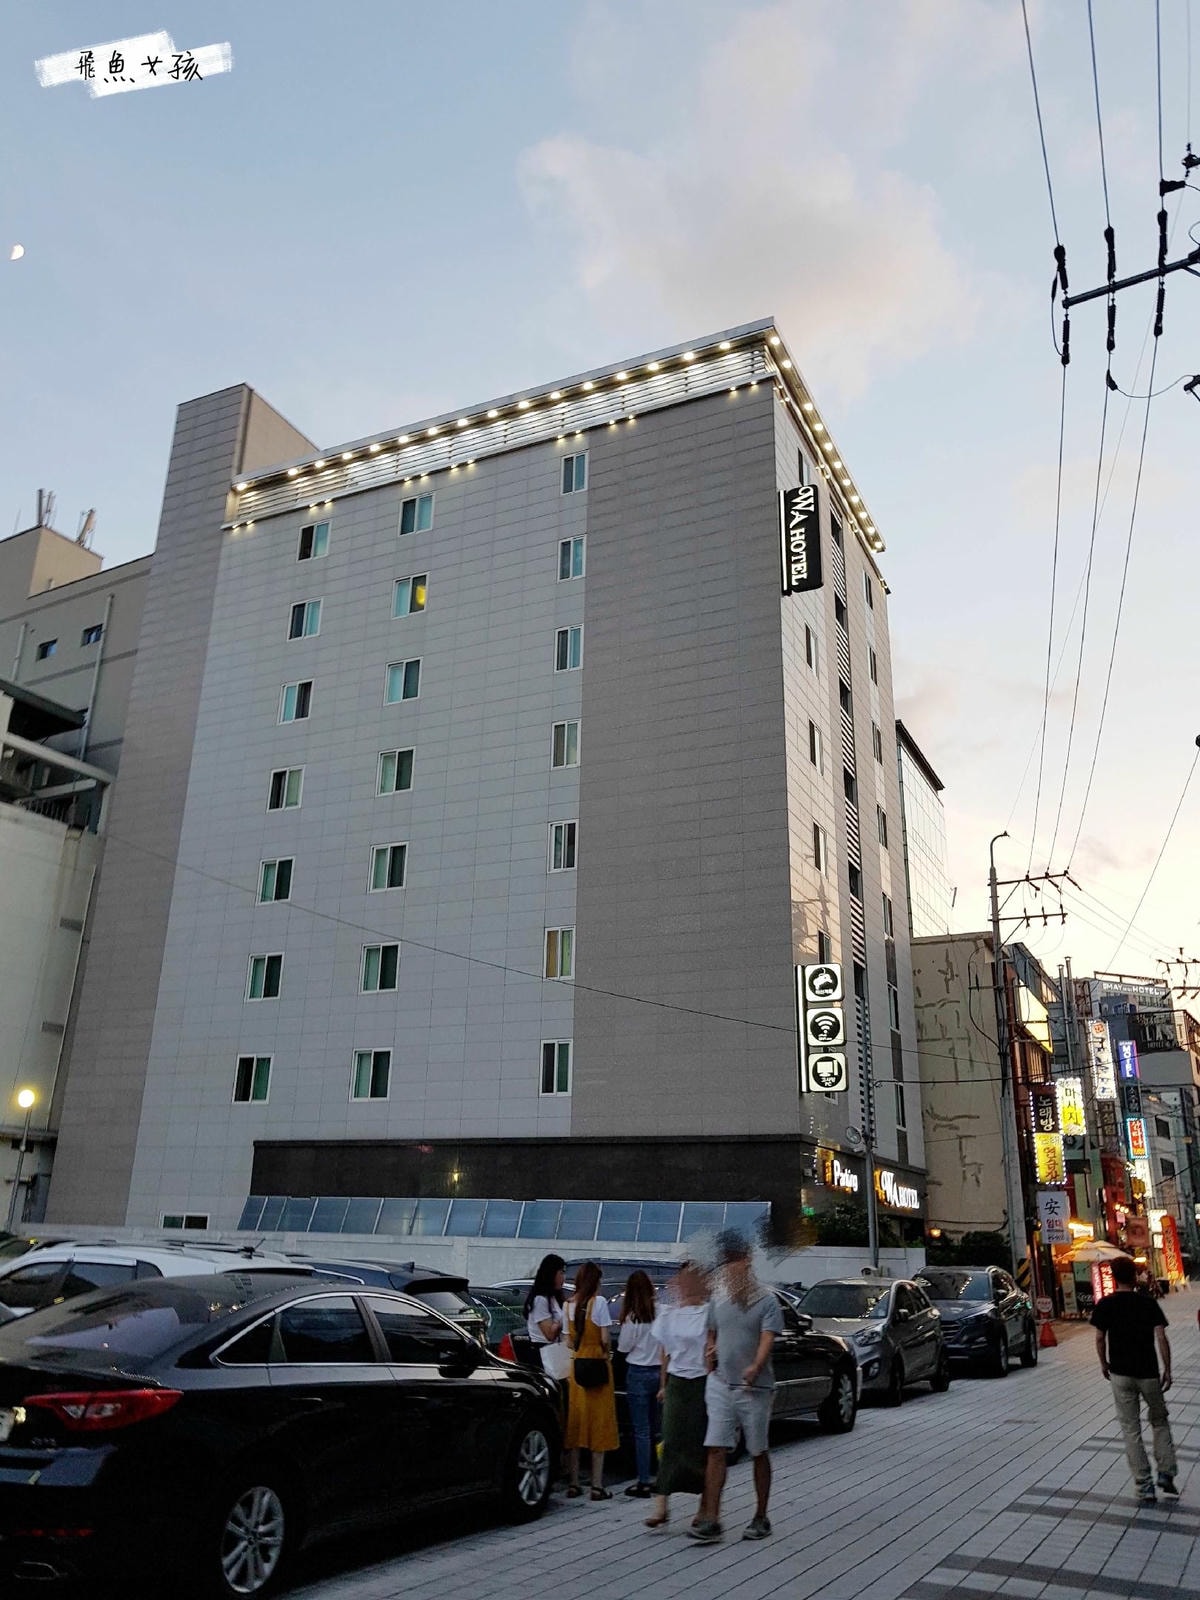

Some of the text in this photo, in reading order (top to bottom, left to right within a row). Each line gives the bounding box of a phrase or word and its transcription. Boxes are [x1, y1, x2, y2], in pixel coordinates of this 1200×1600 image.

[790, 528, 808, 586] HOTEL
[1132, 986, 1160, 995] HOTEL
[1122, 1045, 1133, 1077] MOTEL
[1038, 1096, 1055, 1131] 노래방
[1065, 1088, 1081, 1126] 마사지
[1044, 1198, 1060, 1215] 安
